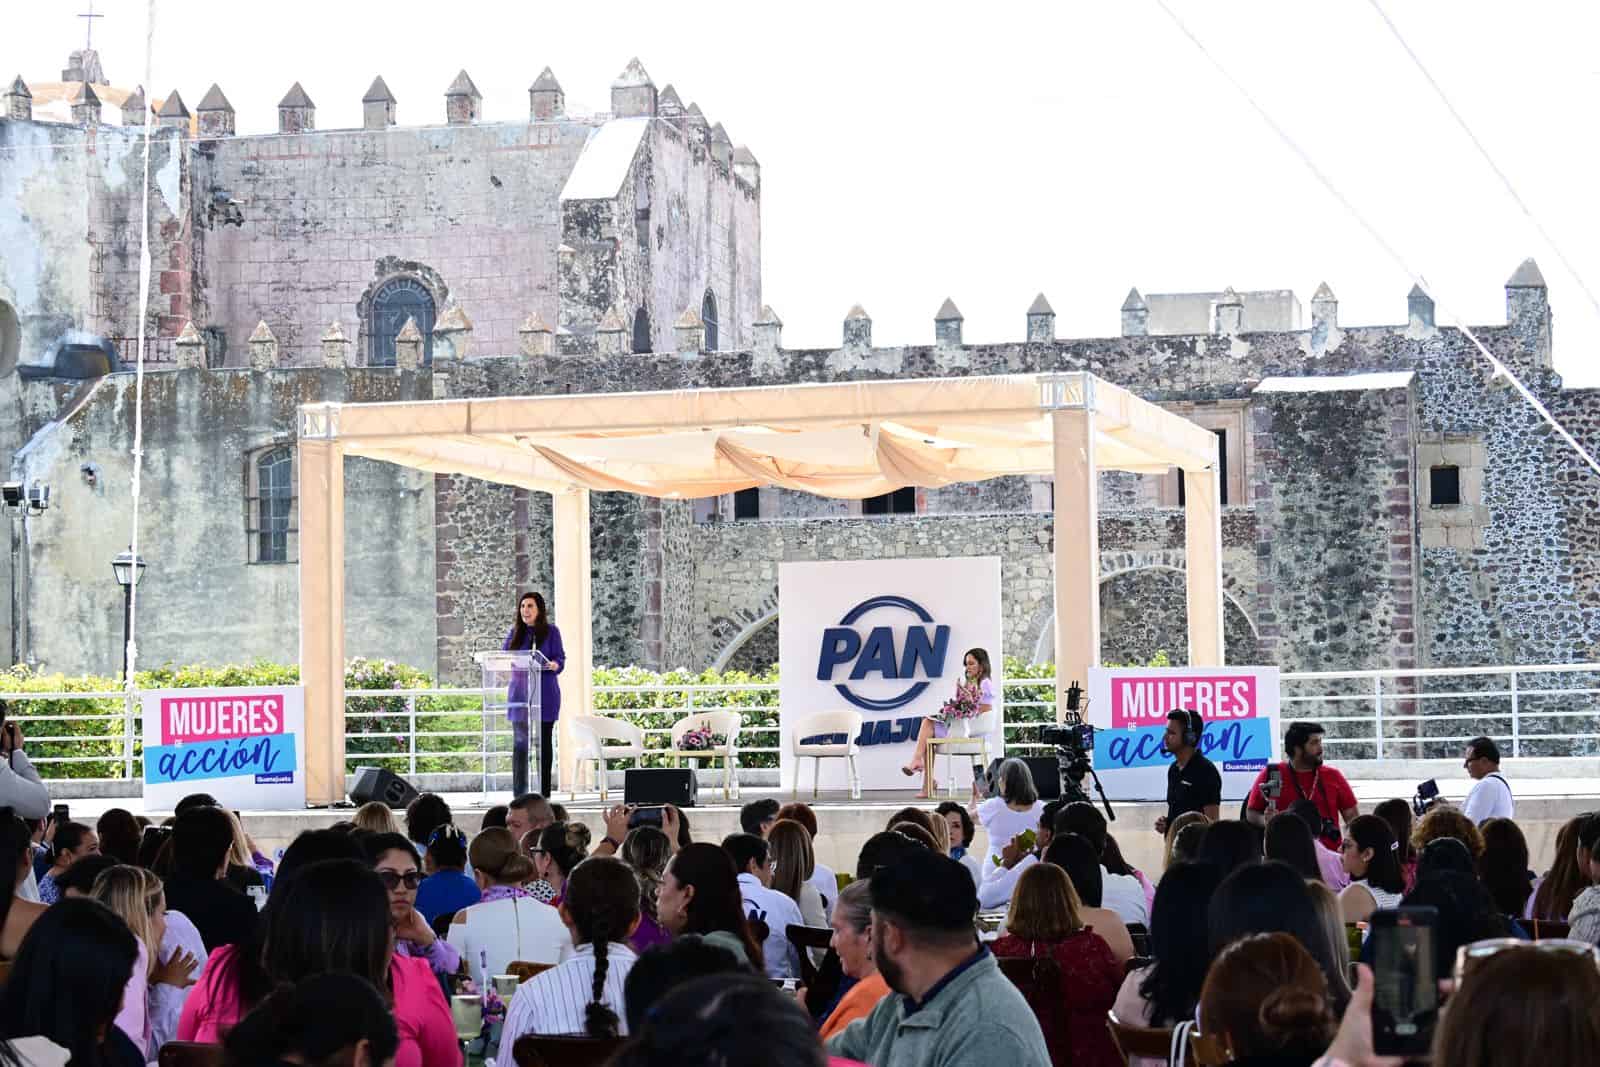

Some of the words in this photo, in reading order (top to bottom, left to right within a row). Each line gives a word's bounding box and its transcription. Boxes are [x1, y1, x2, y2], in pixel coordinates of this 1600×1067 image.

[816, 625, 950, 680] PAN
[169, 699, 278, 735] MUJERES
[1121, 680, 1249, 718] MUJERES
[158, 737, 281, 782] acción
